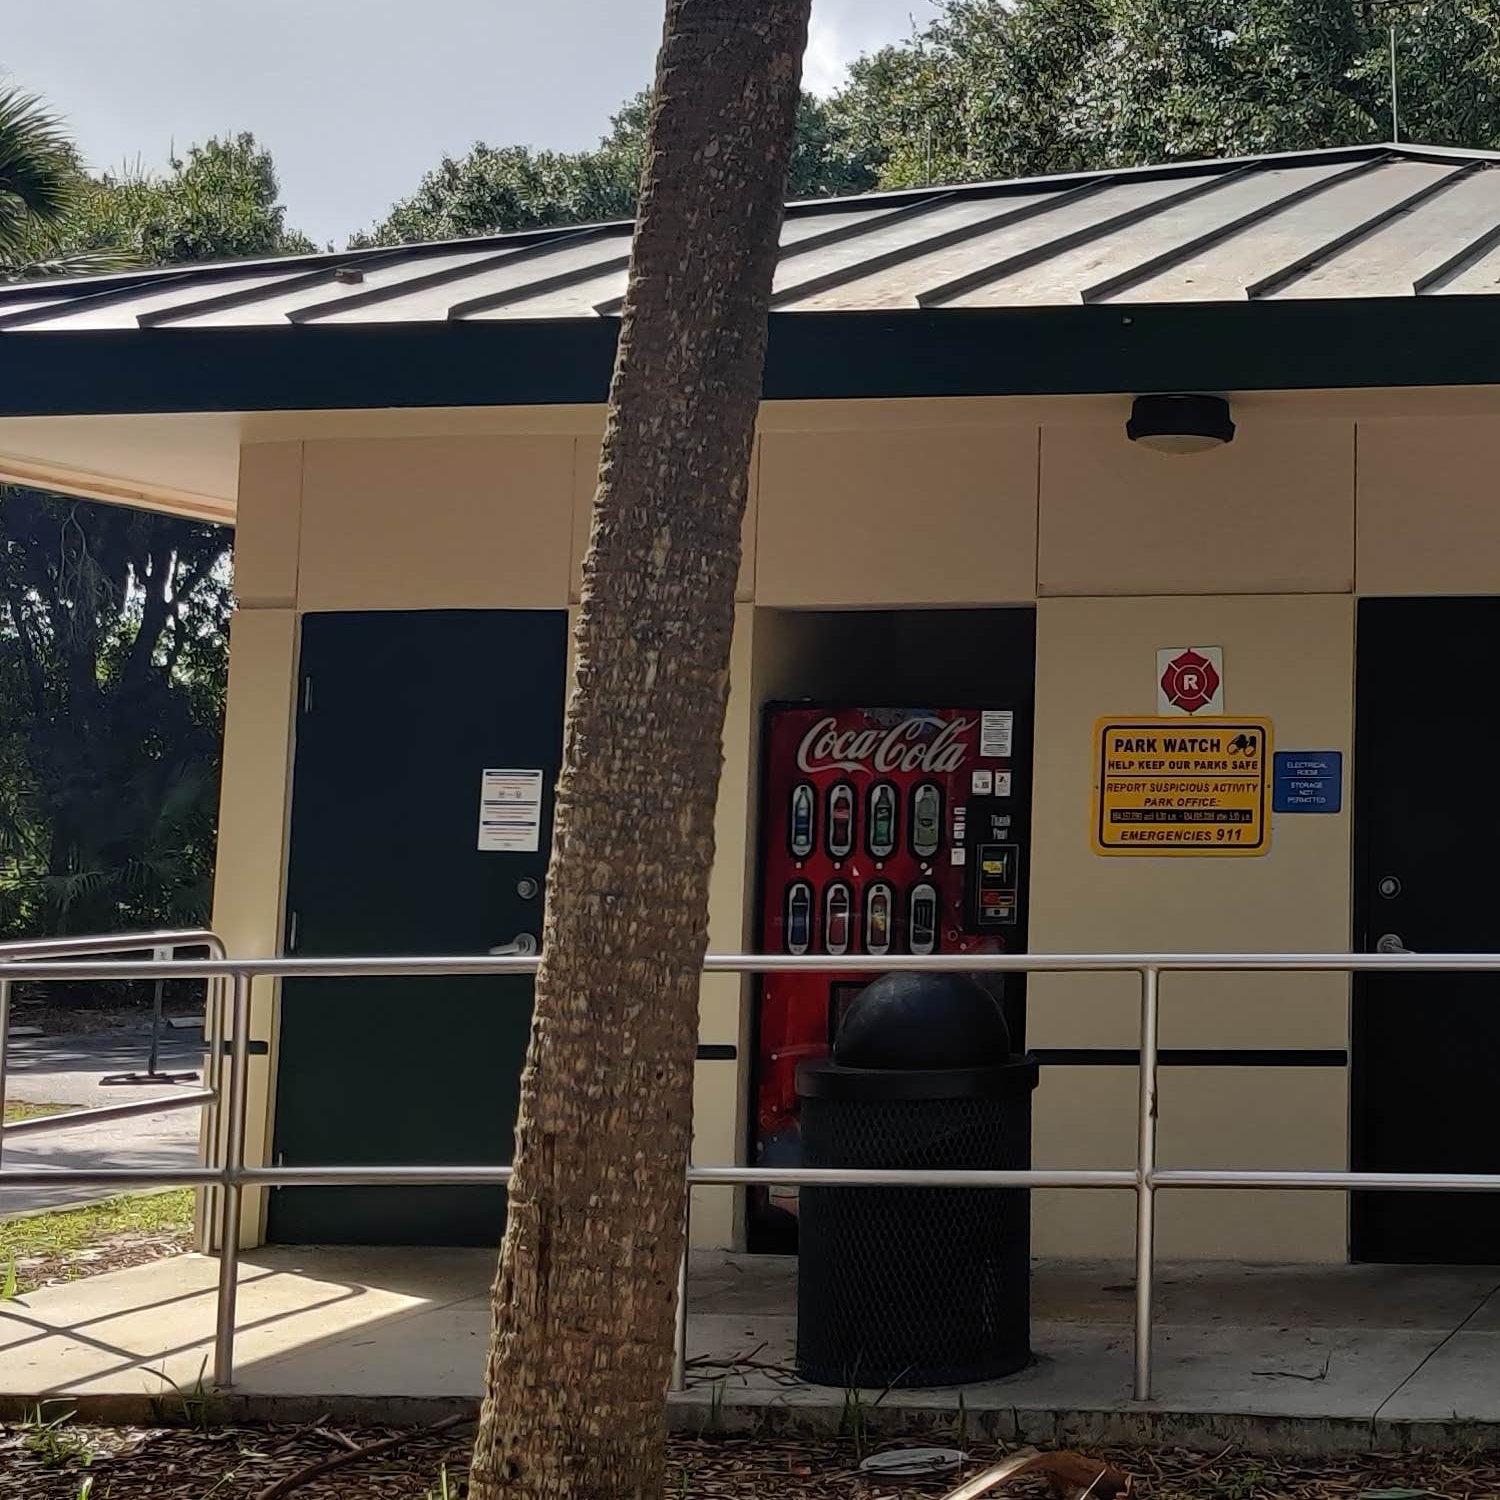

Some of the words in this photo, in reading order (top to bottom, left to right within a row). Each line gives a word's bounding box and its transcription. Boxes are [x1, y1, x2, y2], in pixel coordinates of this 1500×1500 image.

[1183, 674, 1199, 691] R
[1114, 738, 1157, 752] PARK
[1163, 738, 1221, 752] WATCH
[1108, 760, 1134, 770] HELP
[1138, 760, 1165, 770] KEEP
[1168, 760, 1190, 770] OUR
[1194, 760, 1228, 770] PARKS
[1231, 760, 1258, 770] SAFE
[1107, 783, 1146, 793] REPORT
[1149, 783, 1209, 793] SUSPICIOUS
[1212, 783, 1258, 793] ACTIVITY
[1144, 797, 1173, 807] PARK
[1120, 830, 1211, 841] EMERGENCIES
[1216, 828, 1242, 841] 911
